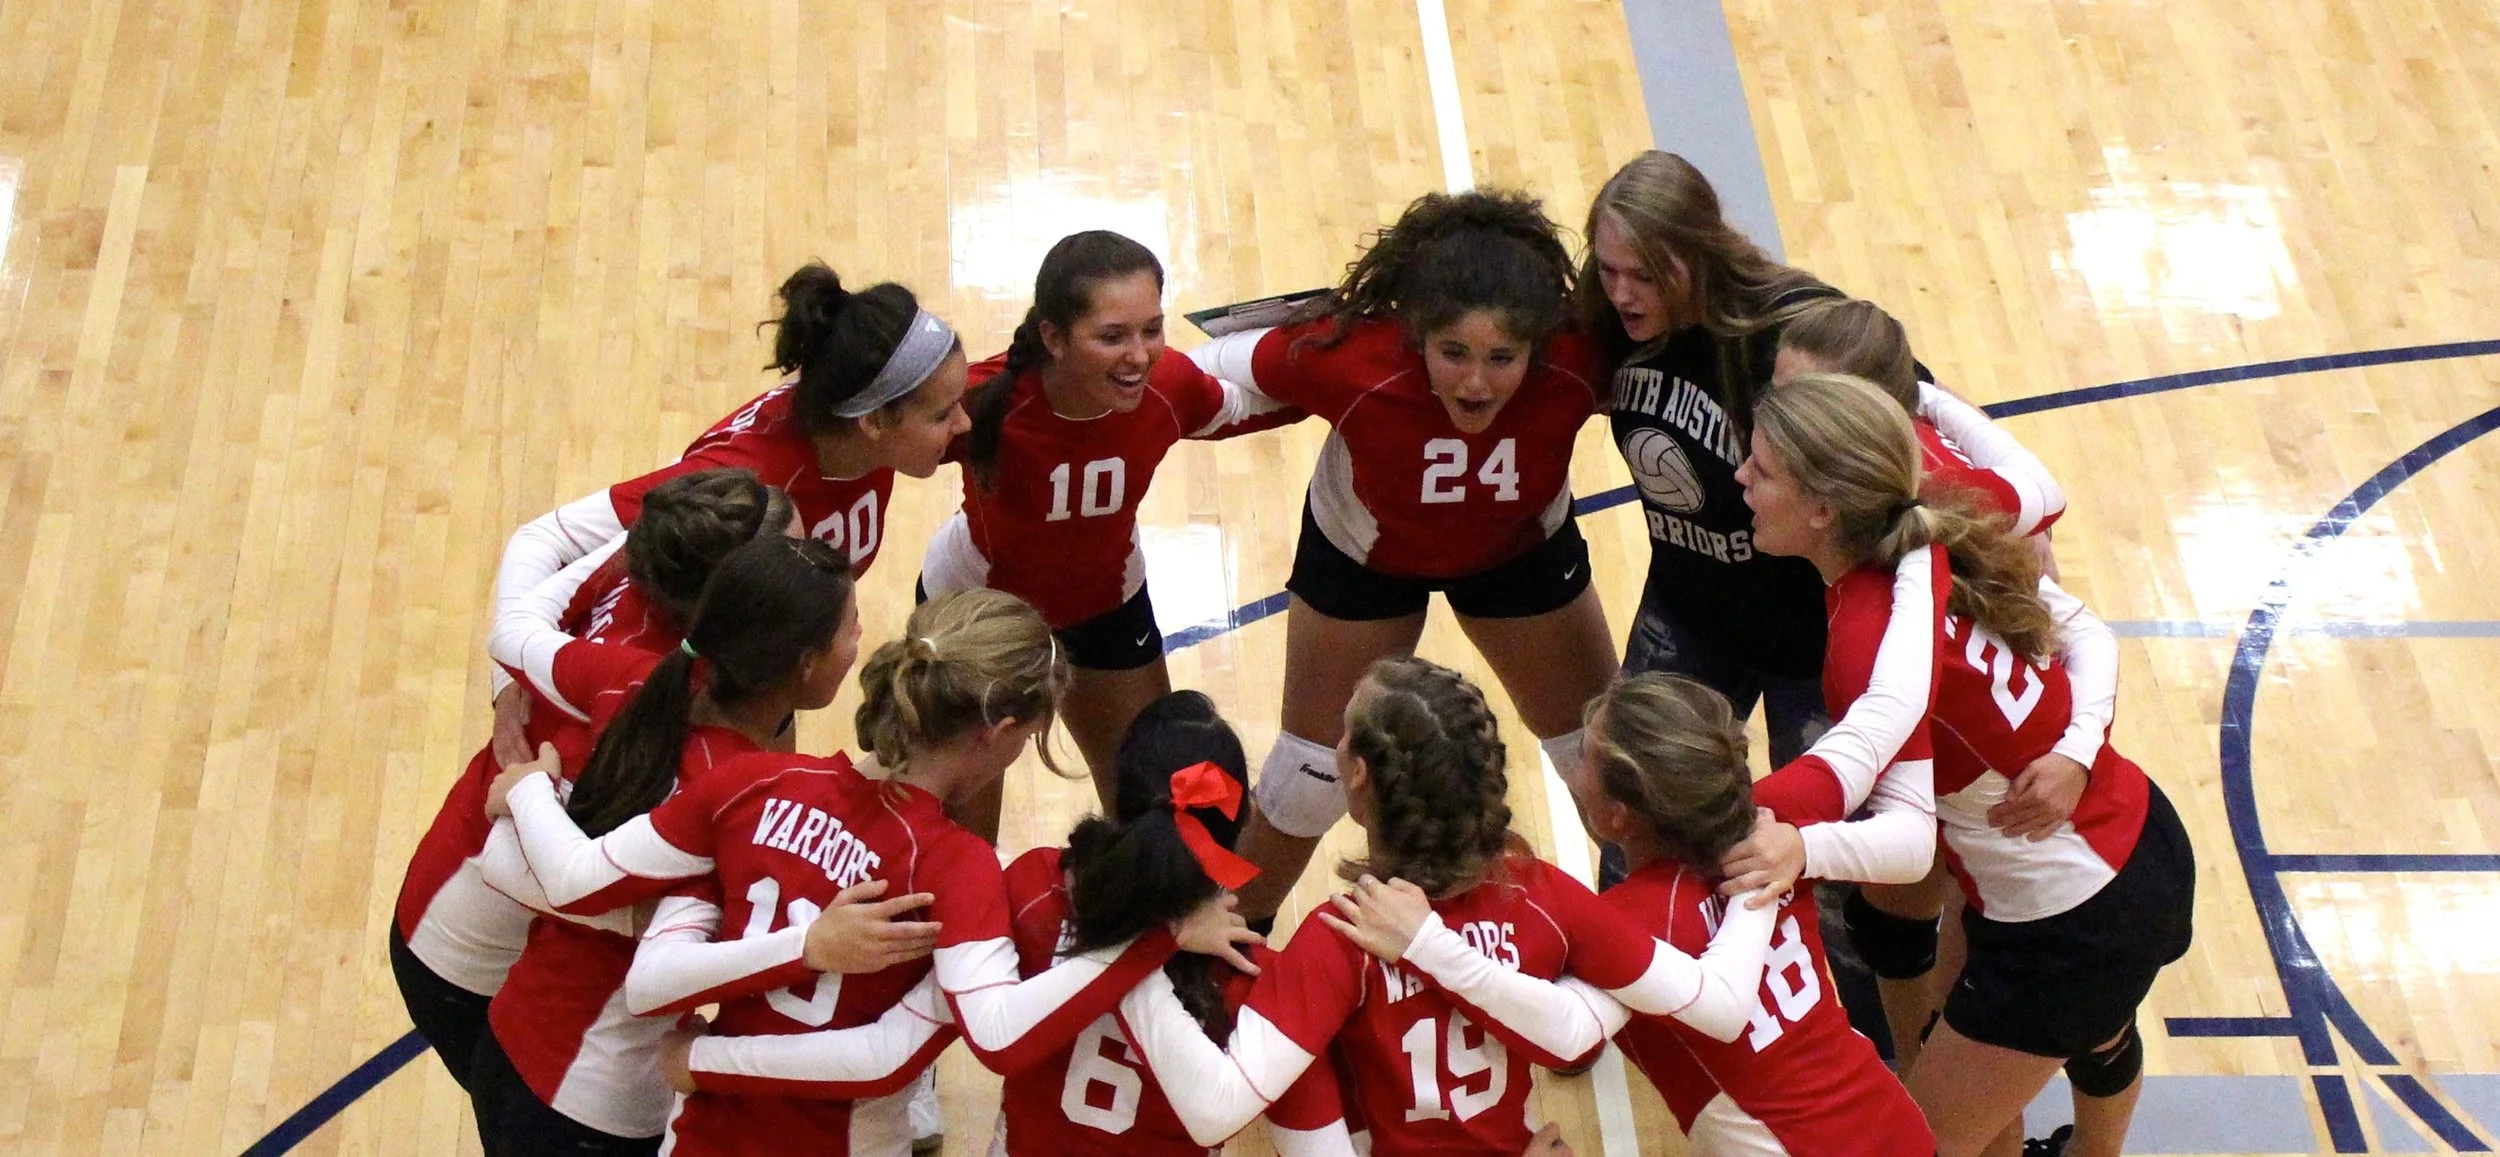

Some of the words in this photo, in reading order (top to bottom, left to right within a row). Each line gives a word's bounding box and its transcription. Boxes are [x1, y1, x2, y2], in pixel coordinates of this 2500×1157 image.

[1611, 367, 1663, 416] OUTH
[1045, 456, 1126, 522] 10
[1421, 438, 1520, 504] 24
[1646, 509, 1753, 564] RRIORS
[1965, 620, 2050, 732] 2
[752, 798, 881, 889] WARRORS
[1060, 1012, 1143, 1135] 6
[1402, 1006, 1508, 1123] 19
